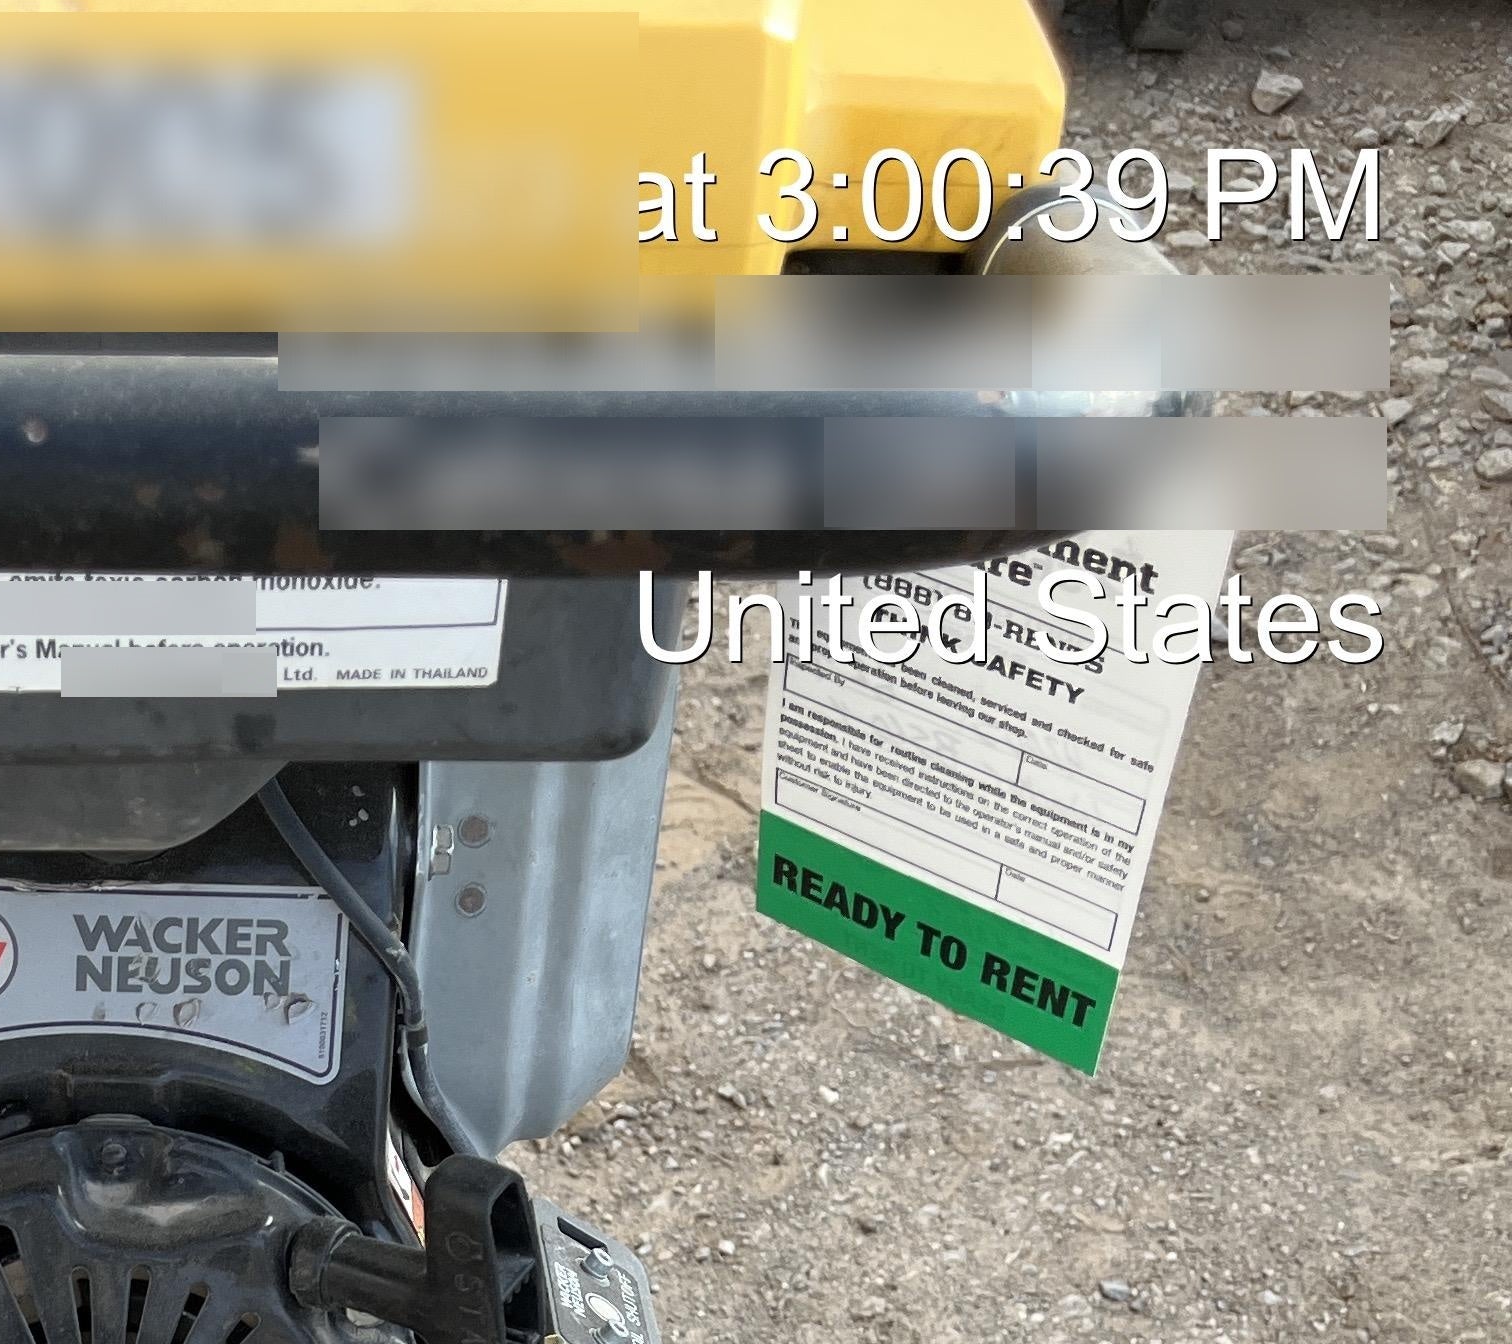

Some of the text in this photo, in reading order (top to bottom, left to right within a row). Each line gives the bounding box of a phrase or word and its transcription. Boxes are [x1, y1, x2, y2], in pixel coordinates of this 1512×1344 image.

[284, 667, 488, 681] Ltd. MADE IN THAILAND
[972, 651, 1085, 705] AFETY
[980, 696, 1026, 721] serviced
[1031, 718, 1052, 732] and
[1057, 728, 1104, 752] checked
[1109, 746, 1125, 759] for
[1130, 757, 1153, 772] safe
[72, 914, 291, 957] WACKER
[772, 853, 1096, 1027] READY TO RENT
[75, 956, 291, 996] NEUSON
